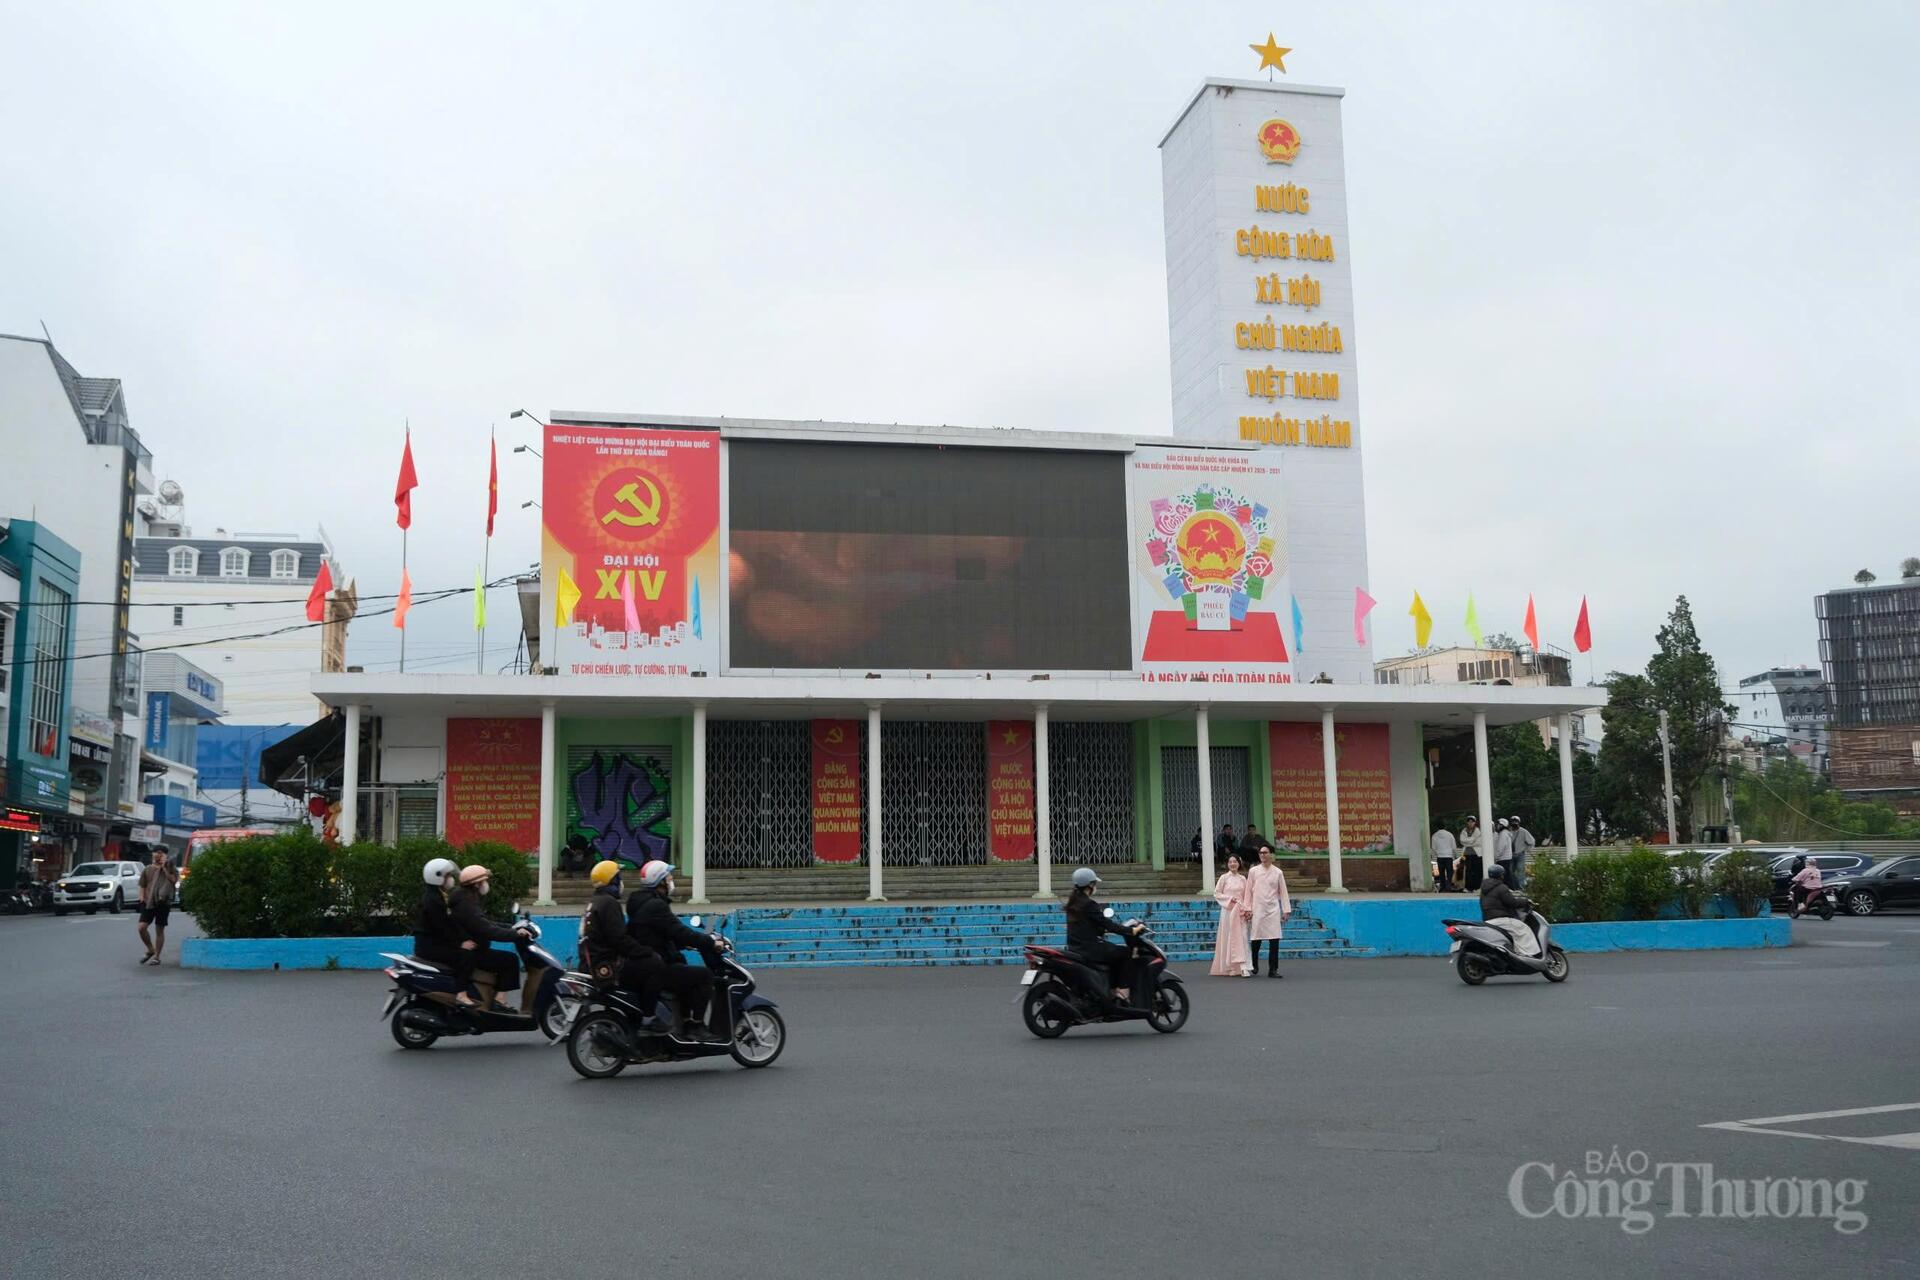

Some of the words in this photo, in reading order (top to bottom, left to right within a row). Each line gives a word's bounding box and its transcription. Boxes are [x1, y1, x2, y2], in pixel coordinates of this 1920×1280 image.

[1256, 182, 1310, 214] NƯỚC
[1235, 224, 1290, 263] CỘNG
[1296, 228, 1335, 262] HÒA
[1256, 272, 1282, 304] XÃ
[1288, 273, 1320, 312] HỘI
[1235, 314, 1276, 350] CHỦ
[1281, 320, 1343, 353] NGHĨA
[1246, 364, 1286, 403] VIỆT
[1293, 370, 1339, 401] NAM
[1239, 411, 1300, 446] MUÔN
[1305, 414, 1352, 448] NĂM
[124, 468, 136, 541] KIM
[603, 554, 628, 567] ĐẠI
[634, 554, 660, 568] HỘI
[595, 569, 667, 601] XIV
[118, 559, 131, 656] OANH
[1212, 668, 1234, 683] CỦA
[824, 760, 848, 774] ĐẢNG
[1000, 761, 1023, 774] NƯỚC
[816, 776, 839, 791] CỘNG
[840, 776, 855, 789] SẢN
[991, 776, 1014, 791] CỘNG
[818, 792, 836, 806] VIỆT
[836, 793, 855, 804] NAM
[999, 792, 1013, 804] XÃ
[1014, 792, 1025, 806] HỘI
[813, 807, 841, 820] QUANG
[842, 807, 861, 818] VINH
[991, 806, 1008, 820] CHỦ
[1009, 808, 1033, 820] NGHĨA
[815, 821, 840, 833] MUÔN
[841, 821, 859, 833] NĂM
[994, 822, 1012, 838] VIỆT
[1013, 824, 1031, 835] NAM
